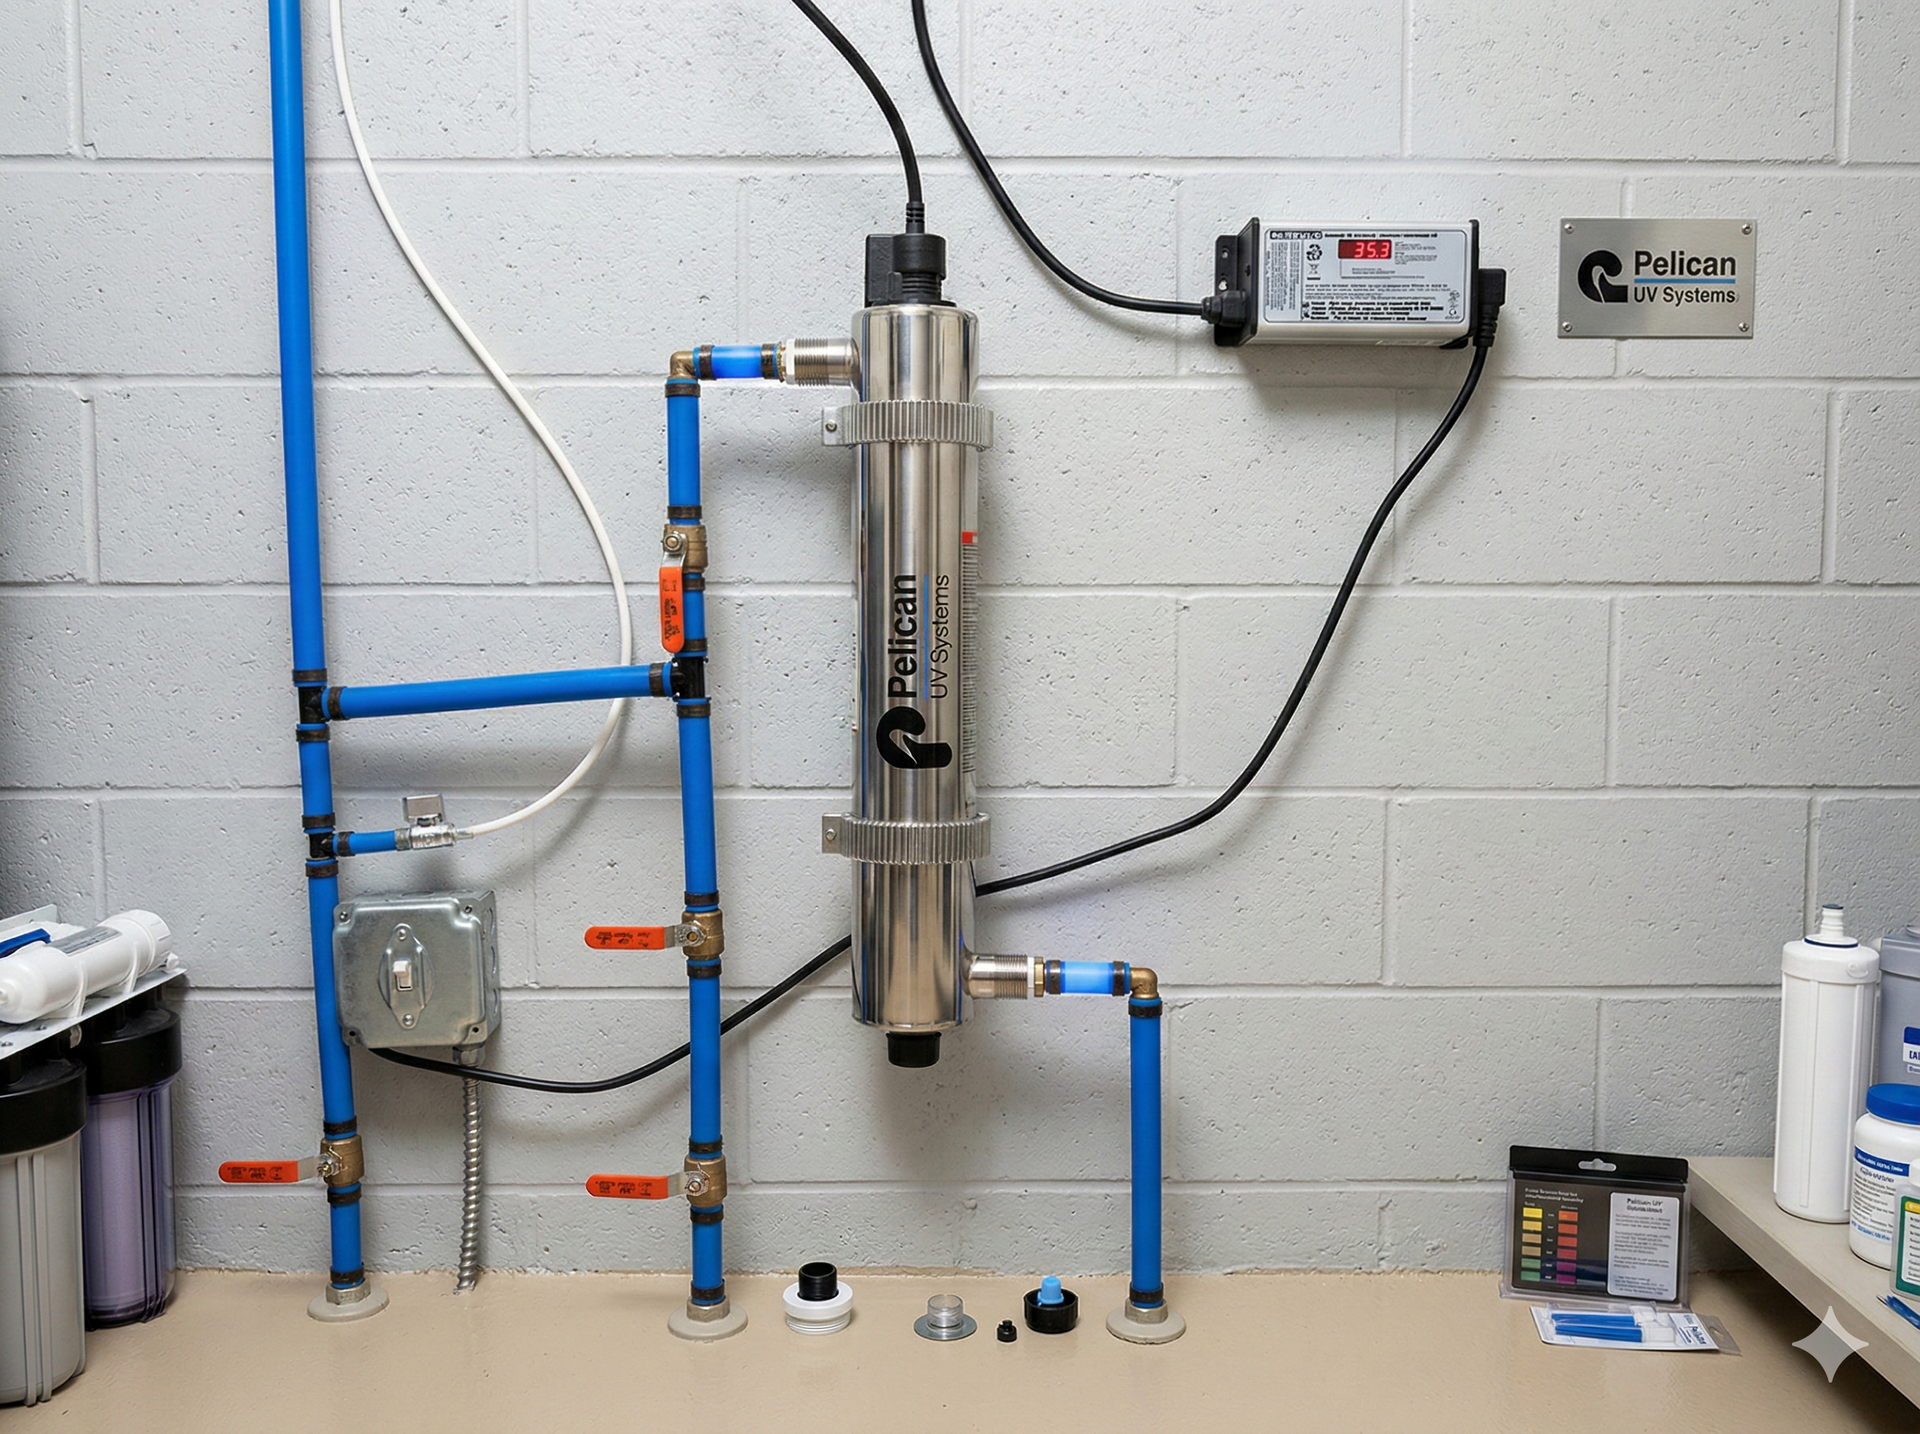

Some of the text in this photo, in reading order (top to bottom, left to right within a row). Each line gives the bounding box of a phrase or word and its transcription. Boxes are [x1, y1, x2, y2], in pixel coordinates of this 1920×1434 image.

[1353, 241, 1391, 258] 35.3
[1634, 250, 1736, 276] Pelican
[1634, 286, 1736, 307] UV Systems
[887, 574, 918, 698] Pelican
[930, 574, 953, 699] UV Systems
